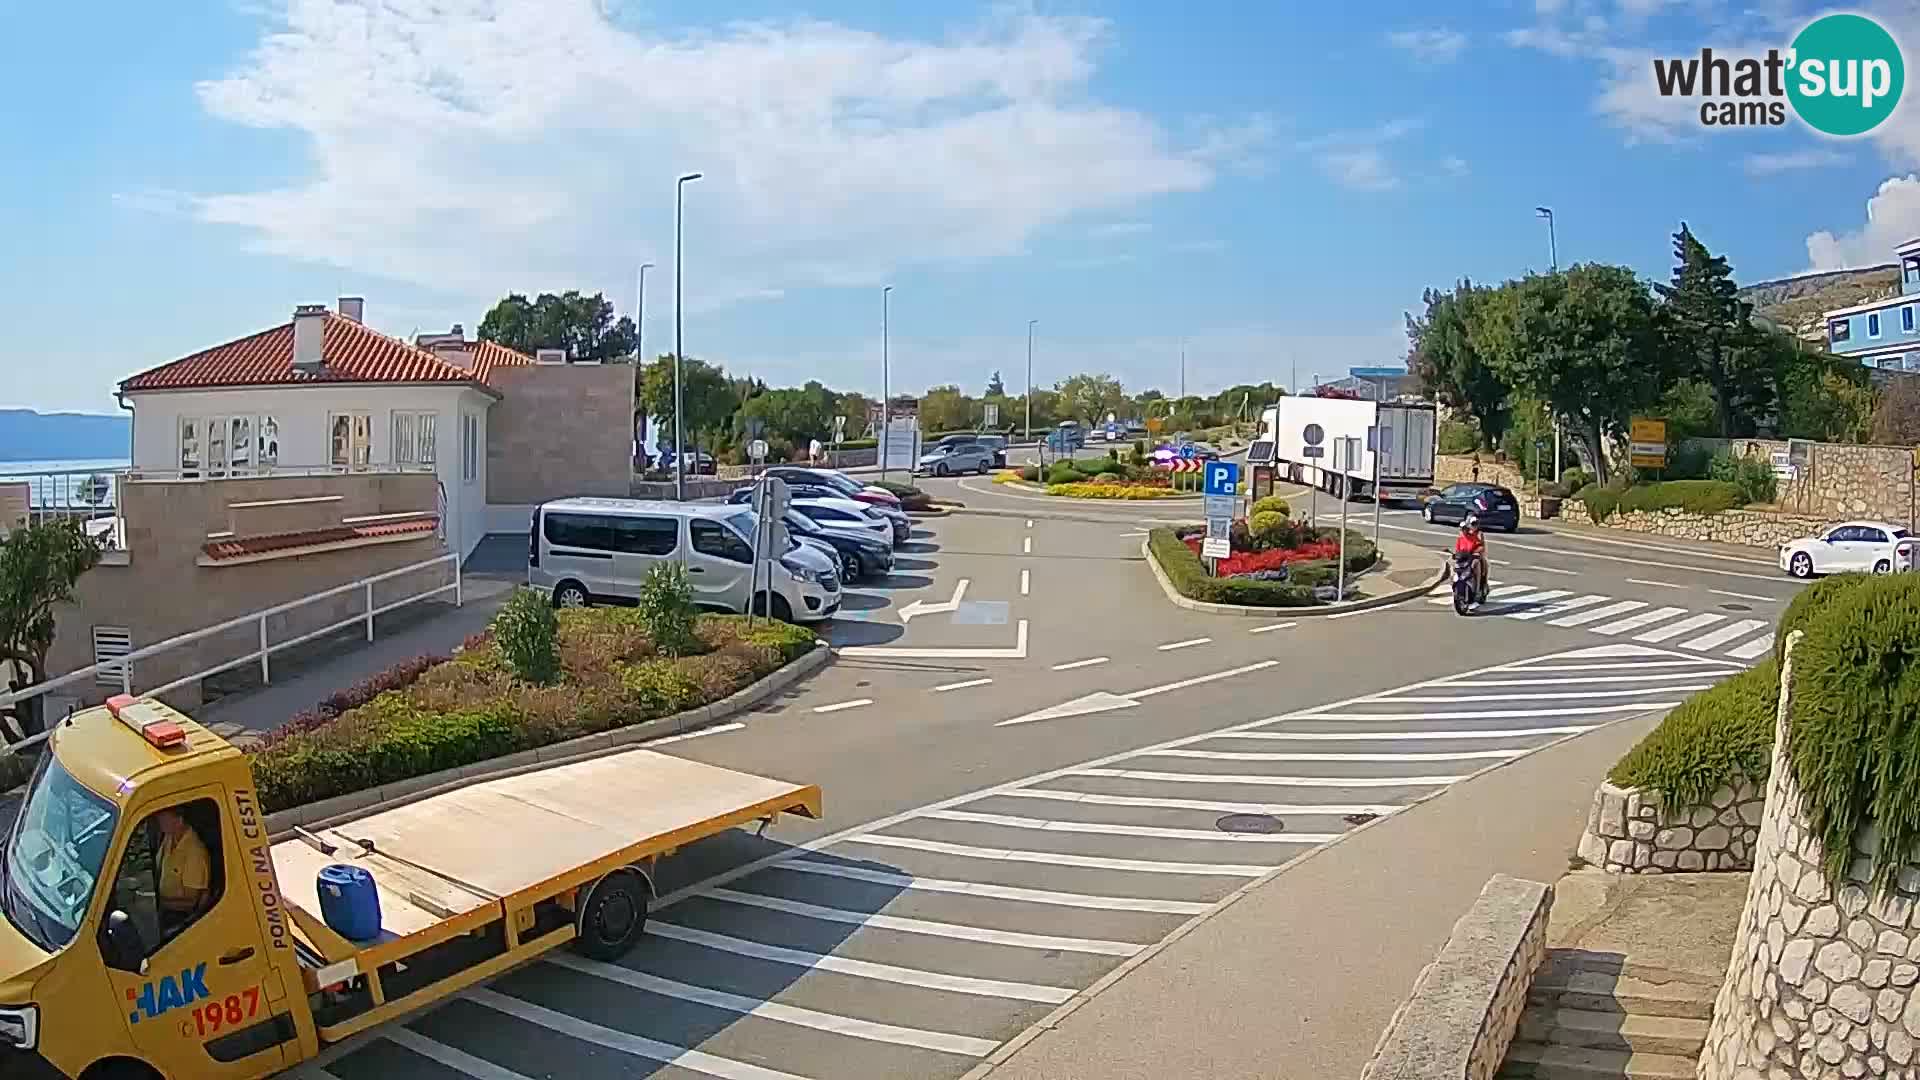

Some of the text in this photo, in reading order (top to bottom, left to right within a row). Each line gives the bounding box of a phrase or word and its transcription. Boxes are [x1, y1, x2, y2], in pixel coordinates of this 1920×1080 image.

[1214, 468, 1229, 488] P
[234, 789, 288, 949] POMOC NA CESTI
[126, 961, 210, 1024] HAK
[191, 985, 260, 1036] 1987
